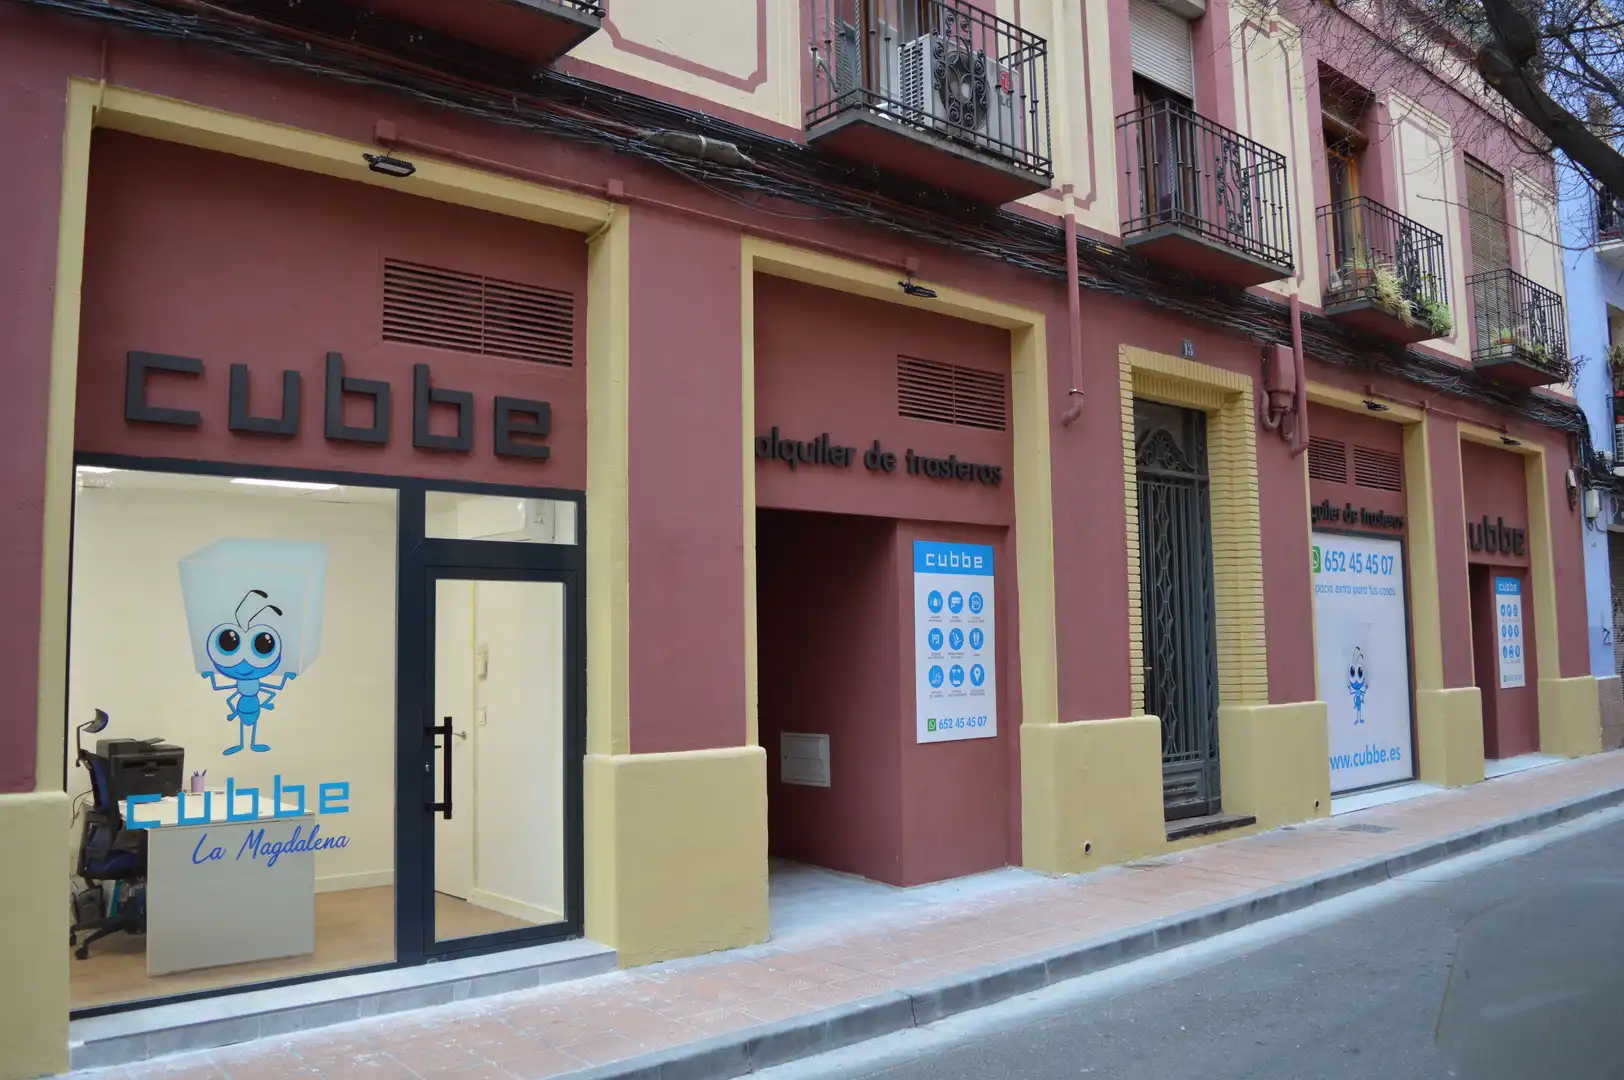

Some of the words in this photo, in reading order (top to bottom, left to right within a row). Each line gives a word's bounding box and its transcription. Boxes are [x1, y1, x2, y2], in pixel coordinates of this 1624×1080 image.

[125, 351, 551, 458] cubbe
[755, 426, 857, 471] alquiler
[864, 440, 897, 473] de
[905, 449, 1003, 484] trasteros
[1343, 502, 1358, 524] de
[1466, 515, 1526, 555] ubbe
[926, 551, 983, 569] cubbe
[1324, 550, 1346, 572] 652
[1349, 552, 1362, 574] 45
[1366, 554, 1379, 575] 45
[1381, 555, 1394, 575] 07
[1353, 586, 1368, 596] para
[938, 718, 953, 729] 652
[955, 717, 965, 728] 45
[966, 716, 976, 727] 45
[977, 716, 987, 727] 07
[126, 774, 349, 830] cubbe
[192, 833, 226, 864] La
[236, 824, 350, 867] Magdalena
